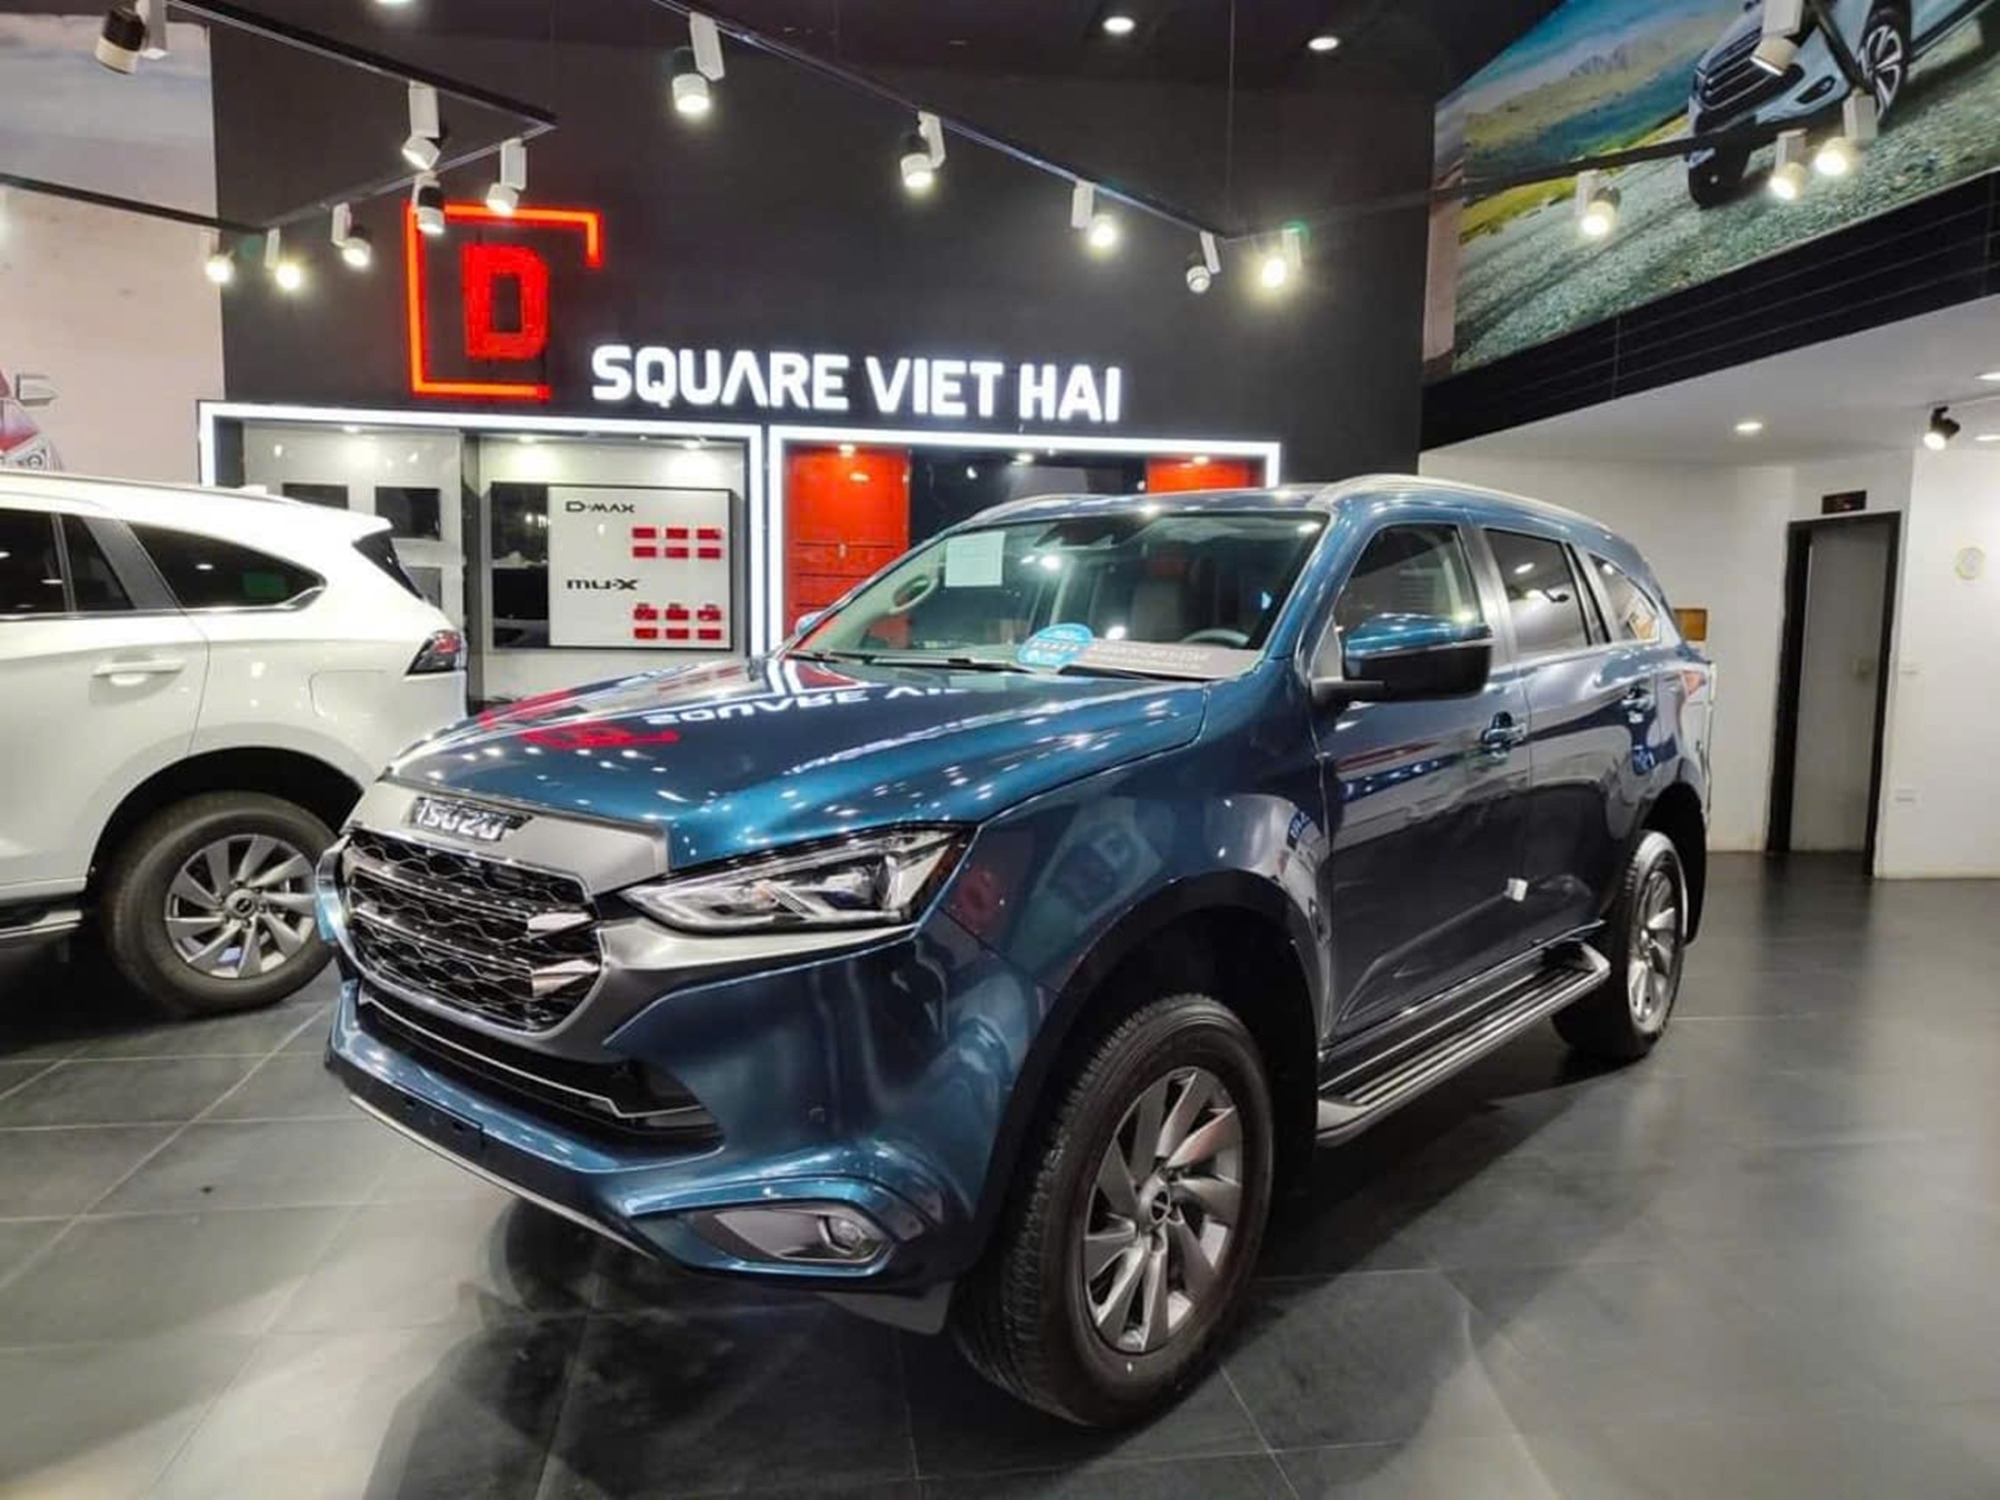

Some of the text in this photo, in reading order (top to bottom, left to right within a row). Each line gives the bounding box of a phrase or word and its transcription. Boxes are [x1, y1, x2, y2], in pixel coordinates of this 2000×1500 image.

[462, 241, 548, 360] D
[591, 343, 1123, 424] SQUARE VIET HAI
[565, 500, 636, 513] D-MAX
[417, 799, 506, 840] ISUZU
